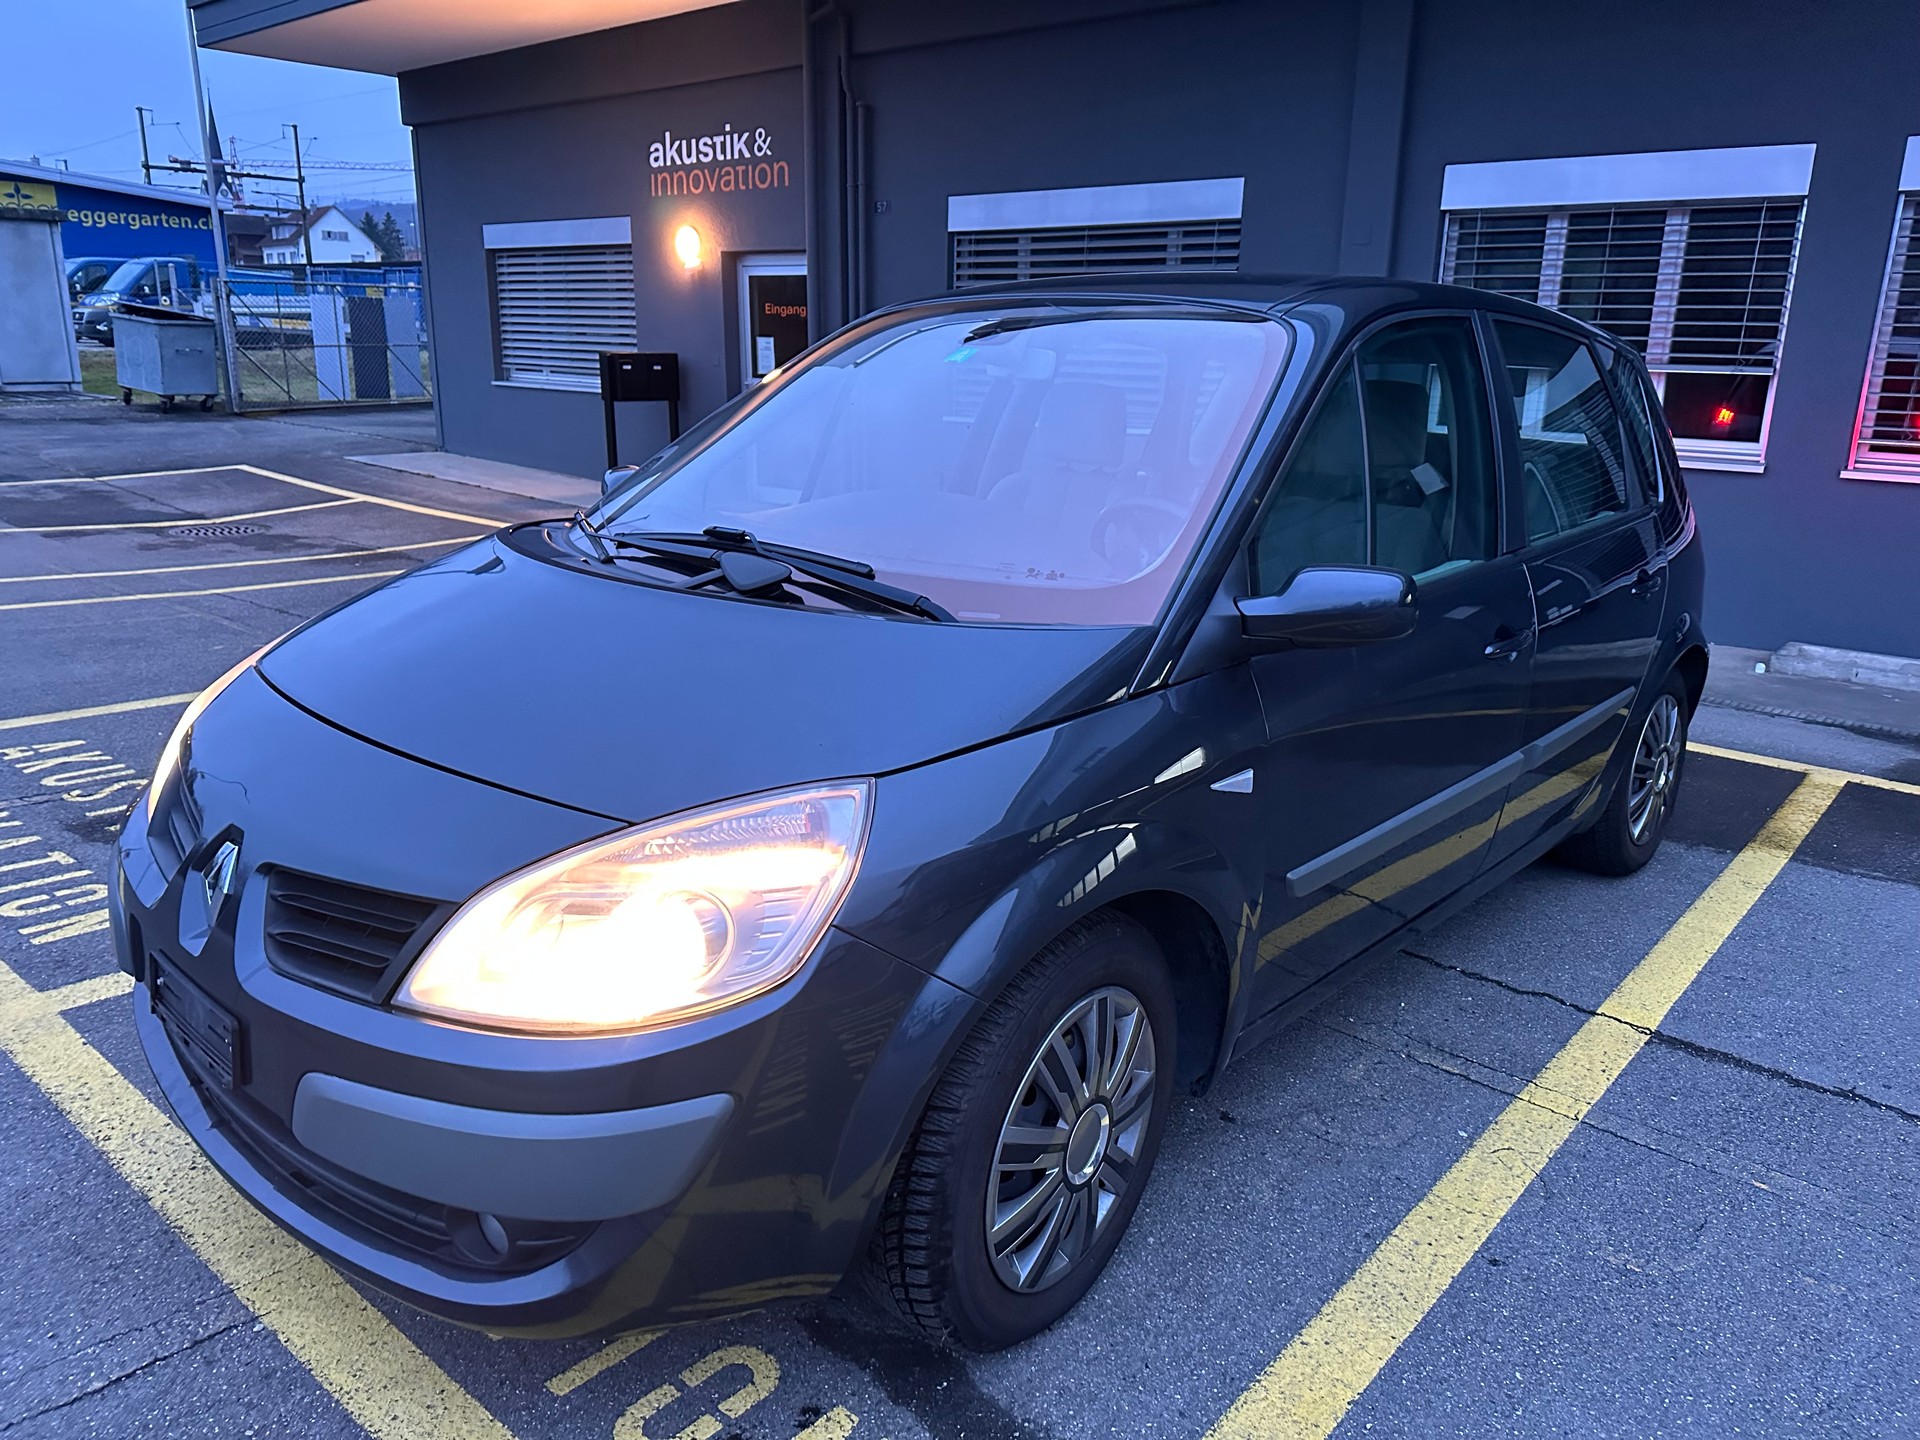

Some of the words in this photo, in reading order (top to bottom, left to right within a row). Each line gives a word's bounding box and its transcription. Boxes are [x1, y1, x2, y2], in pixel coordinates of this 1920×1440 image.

[649, 123, 751, 168] akustik
[753, 127, 772, 157] &
[651, 160, 789, 197] innovation
[876, 201, 887, 213] 57
[764, 303, 807, 317] Eingang
